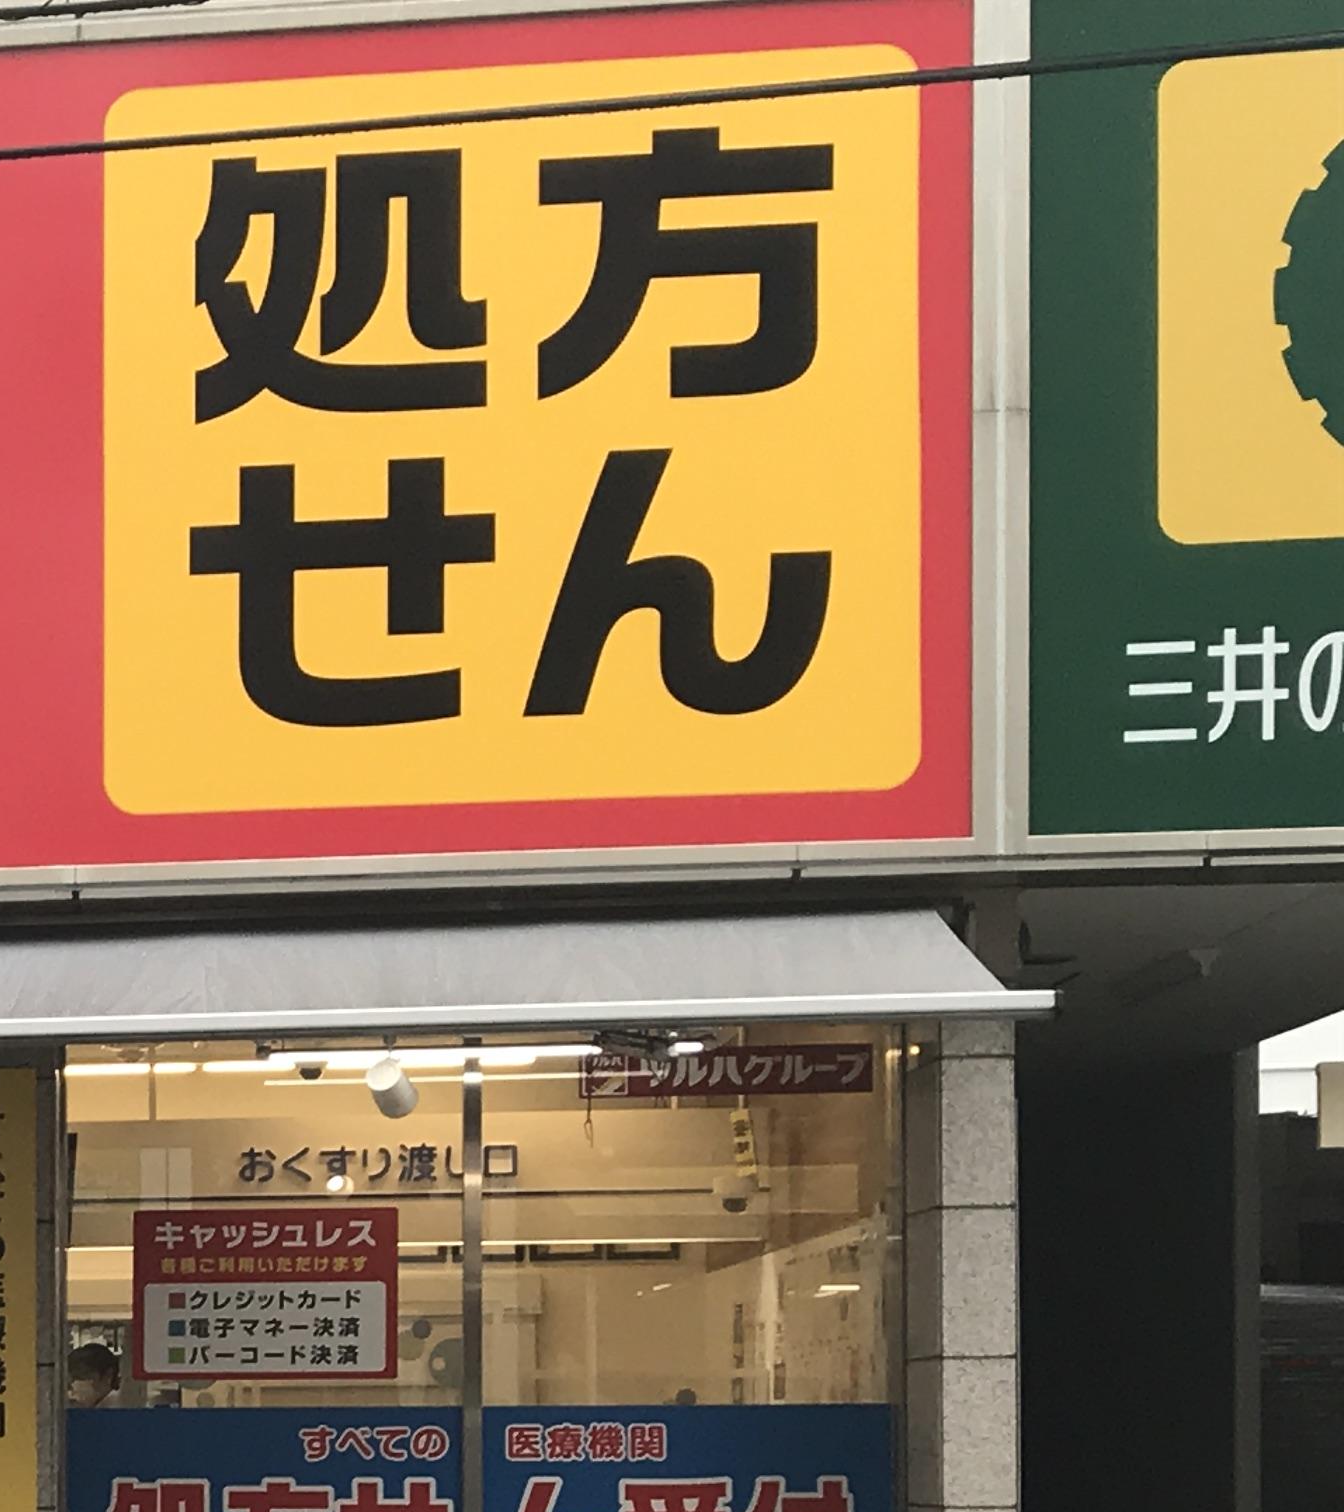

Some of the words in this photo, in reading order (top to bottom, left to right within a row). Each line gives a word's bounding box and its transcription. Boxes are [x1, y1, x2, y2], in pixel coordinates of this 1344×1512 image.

[194, 125, 835, 425] 処方
[189, 446, 833, 729] せん
[238, 1142, 518, 1183] おくすり渡し口
[154, 1219, 377, 1251] キャッシュレス
[189, 1290, 361, 1310] クレジットカード
[189, 1318, 361, 1339] 電子マネー決済
[189, 1345, 360, 1366] バーコード決済
[300, 1423, 451, 1464] すべての
[503, 1422, 669, 1464] 医療機関
